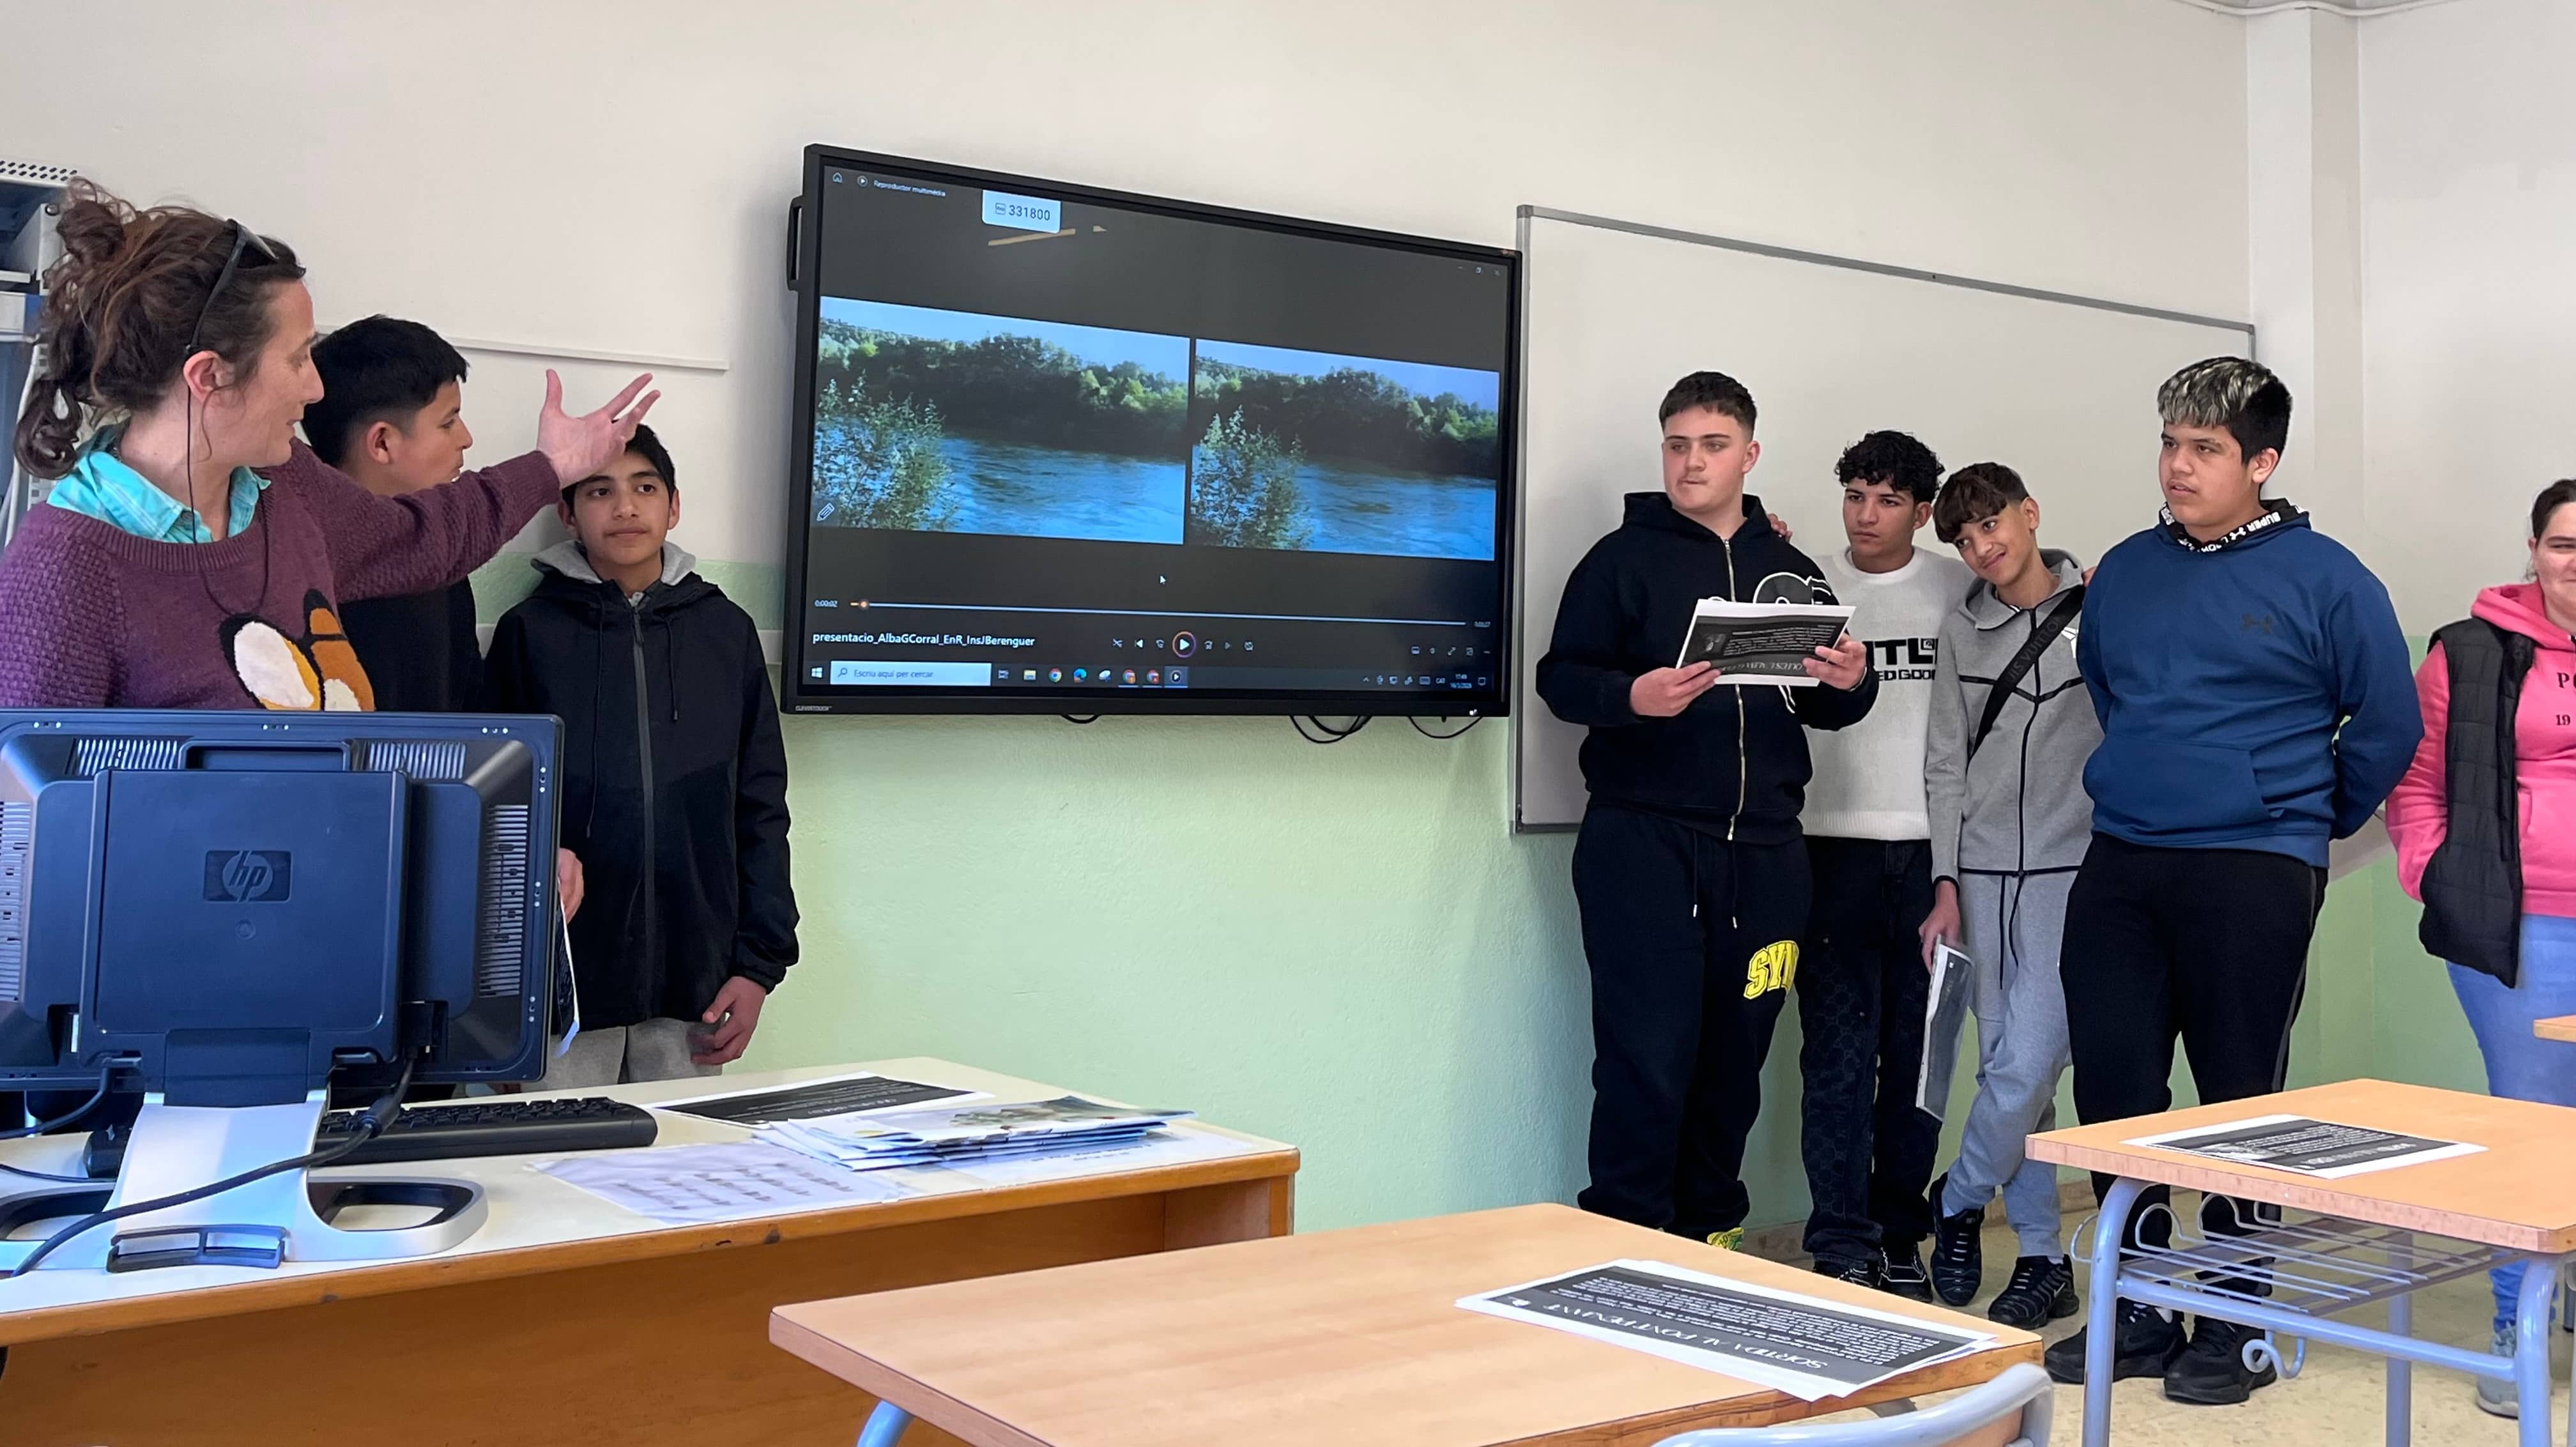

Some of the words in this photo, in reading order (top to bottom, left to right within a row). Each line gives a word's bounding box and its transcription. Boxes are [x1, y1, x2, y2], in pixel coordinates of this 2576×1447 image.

[1009, 204, 1050, 221] 331800
[2557, 671, 2576, 689] P
[229, 851, 268, 903] hp
